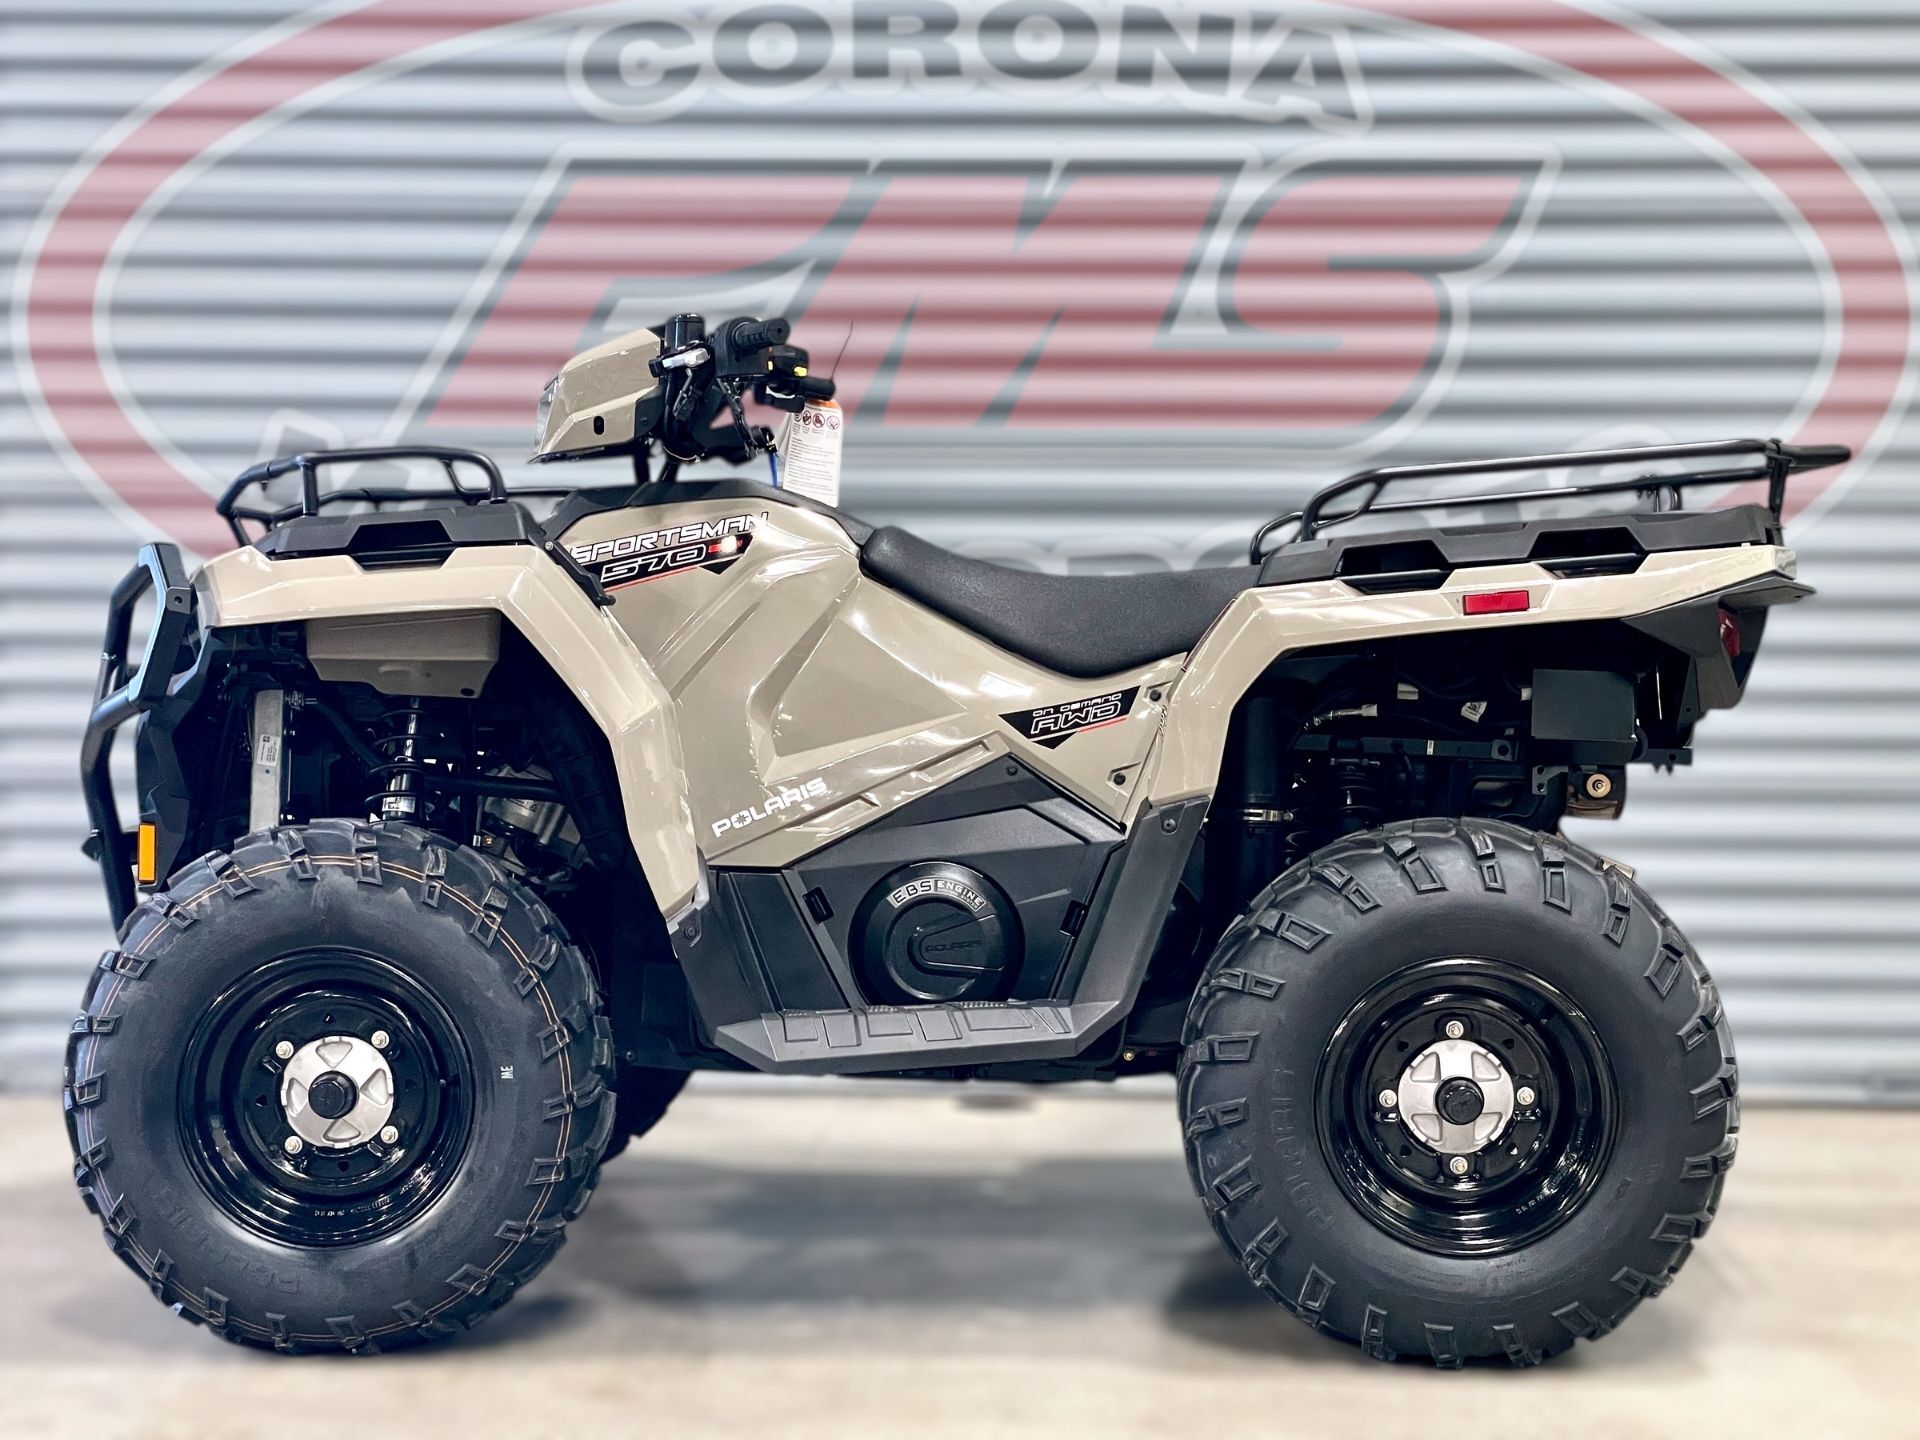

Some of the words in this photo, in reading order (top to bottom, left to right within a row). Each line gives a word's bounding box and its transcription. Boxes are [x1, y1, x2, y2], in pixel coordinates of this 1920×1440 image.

[580, 0, 1360, 124] CORONA
[420, 157, 1550, 431] PMS
[570, 512, 769, 563] SPORTSMAN
[600, 544, 707, 583] 570
[1030, 701, 1121, 735] AWD
[711, 776, 828, 839] POLARIS
[892, 880, 932, 904] EBS
[937, 880, 983, 906] ENGINE
[925, 940, 982, 953] POLARIS
